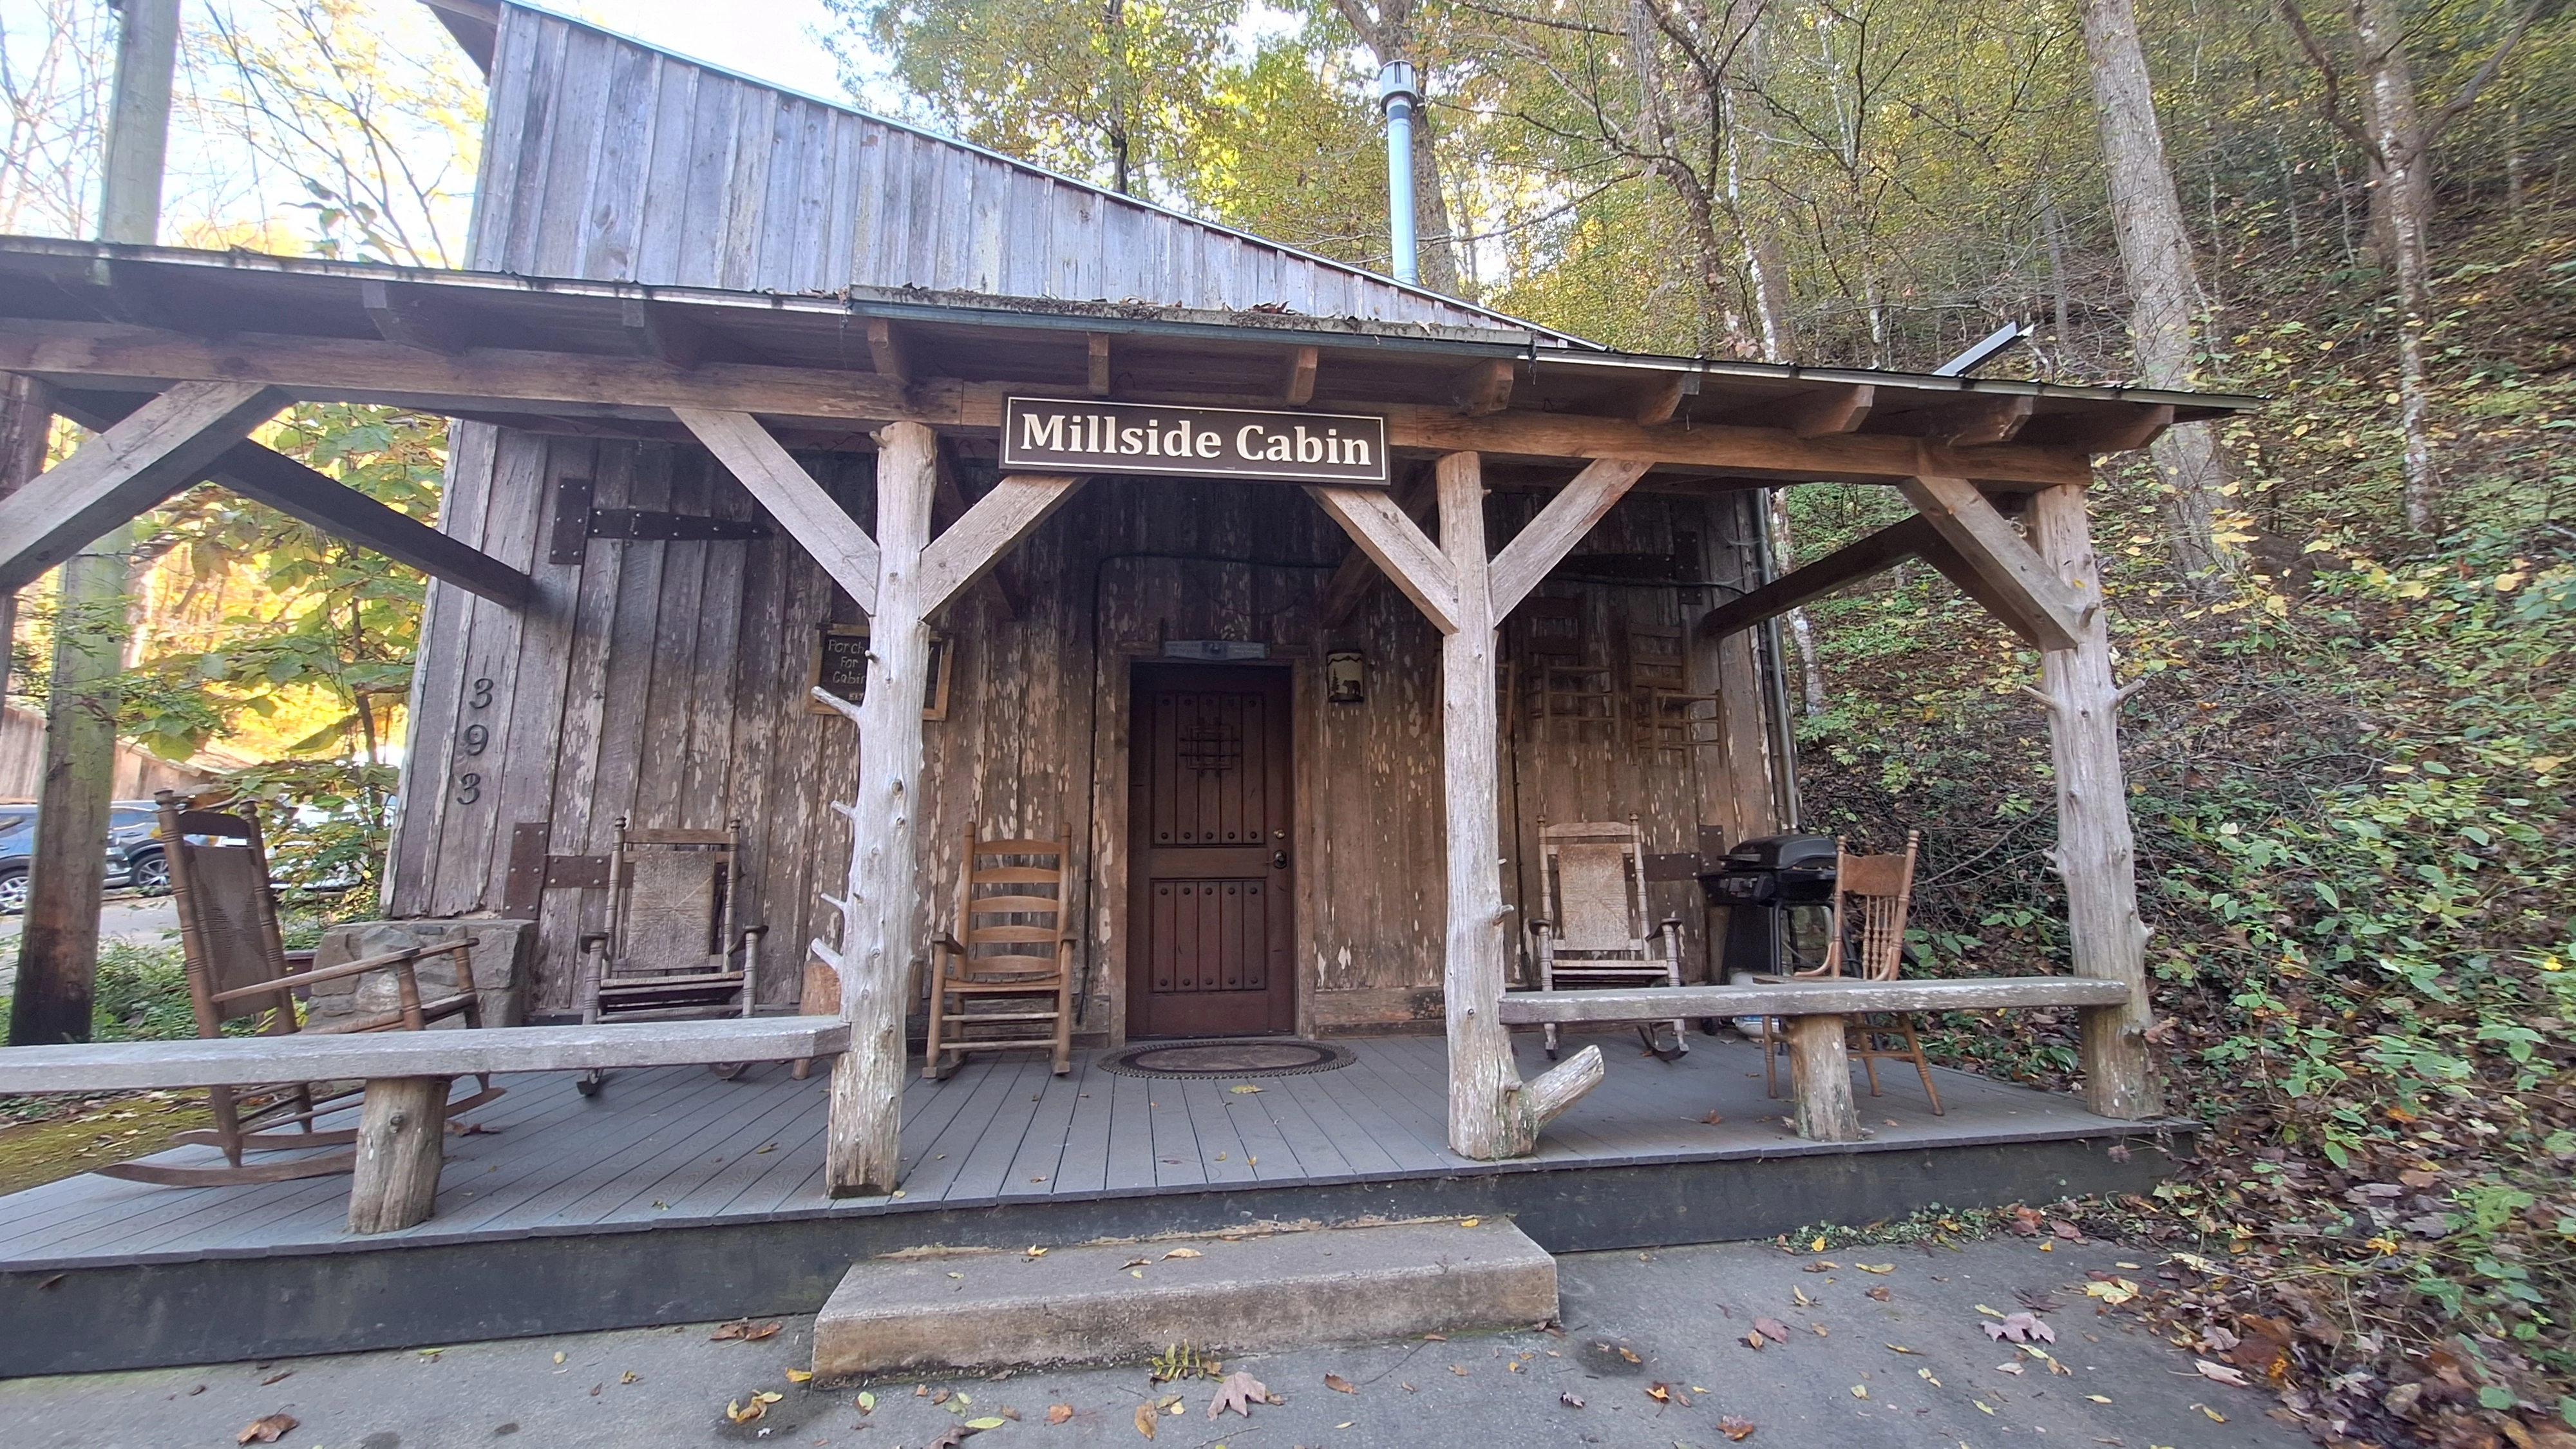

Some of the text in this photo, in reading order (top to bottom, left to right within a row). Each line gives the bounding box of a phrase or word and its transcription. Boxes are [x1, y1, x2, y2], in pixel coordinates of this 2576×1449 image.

[1021, 413, 1371, 465] Millside Cabin
[828, 639, 864, 654] Porch
[840, 656, 858, 668] For
[457, 678, 494, 804] 393
